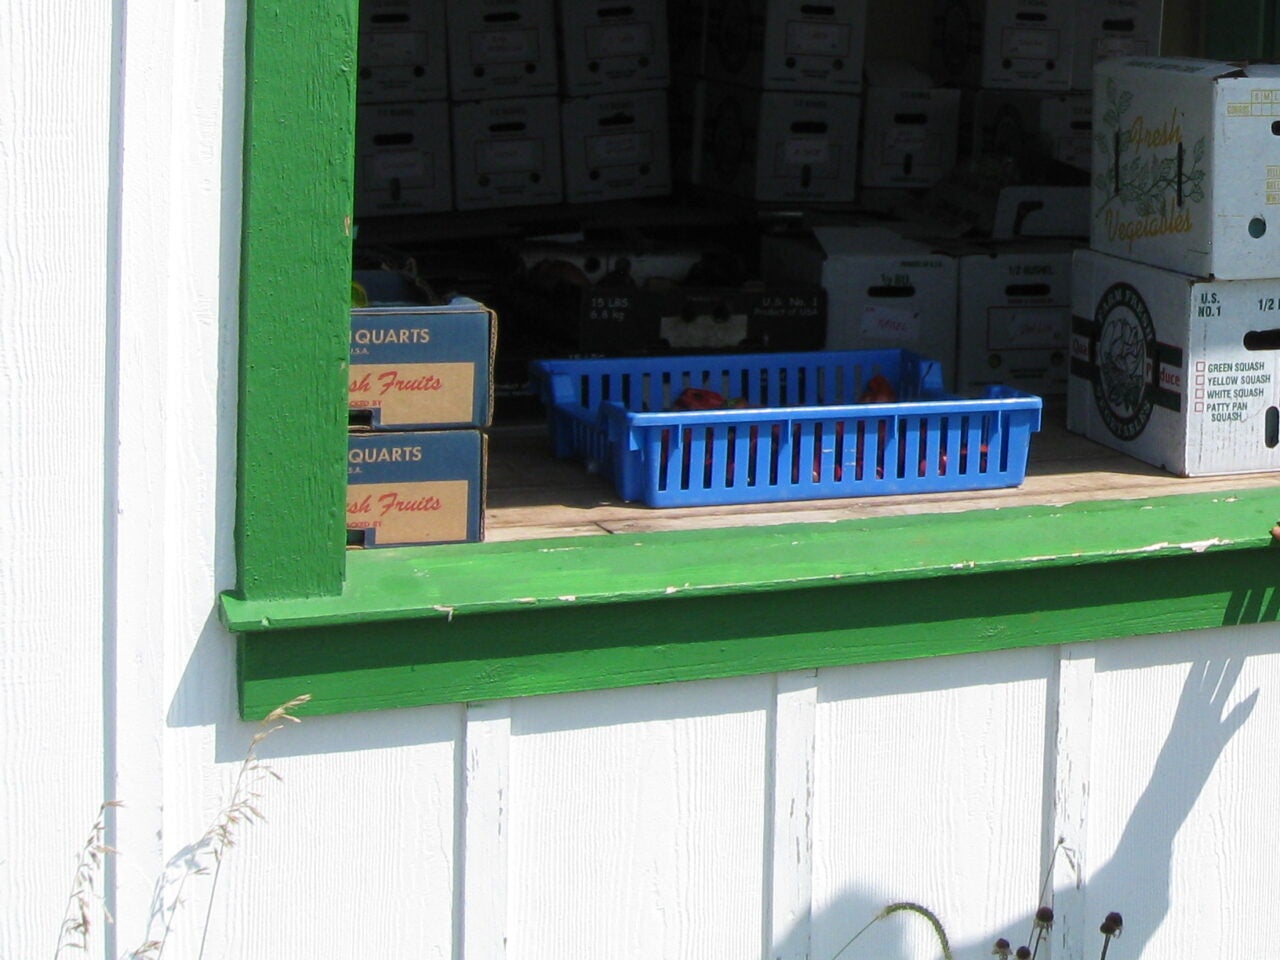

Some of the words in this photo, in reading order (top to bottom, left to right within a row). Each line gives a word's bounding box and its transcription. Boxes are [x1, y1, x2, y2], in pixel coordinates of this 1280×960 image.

[1129, 107, 1183, 154] Fresh
[1105, 197, 1193, 251] Vegetables
[1201, 293, 1220, 304] U.S.
[1258, 298, 1274, 312] 1/2
[355, 329, 430, 344] QUARTS
[1208, 363, 1233, 373] GREEN
[1234, 361, 1265, 372] SQUASH
[377, 370, 442, 396] Fruits
[1207, 376, 1239, 386] YELLOW
[1240, 374, 1271, 385] SQUASH
[1207, 389, 1232, 399] WHITE
[1233, 388, 1264, 398] SQUASH
[1206, 403, 1229, 413] PATTY
[1232, 402, 1247, 411] PAN
[1211, 412, 1242, 422] SQUASH
[348, 446, 422, 464] QUARTS
[378, 492, 442, 517] Fruits
